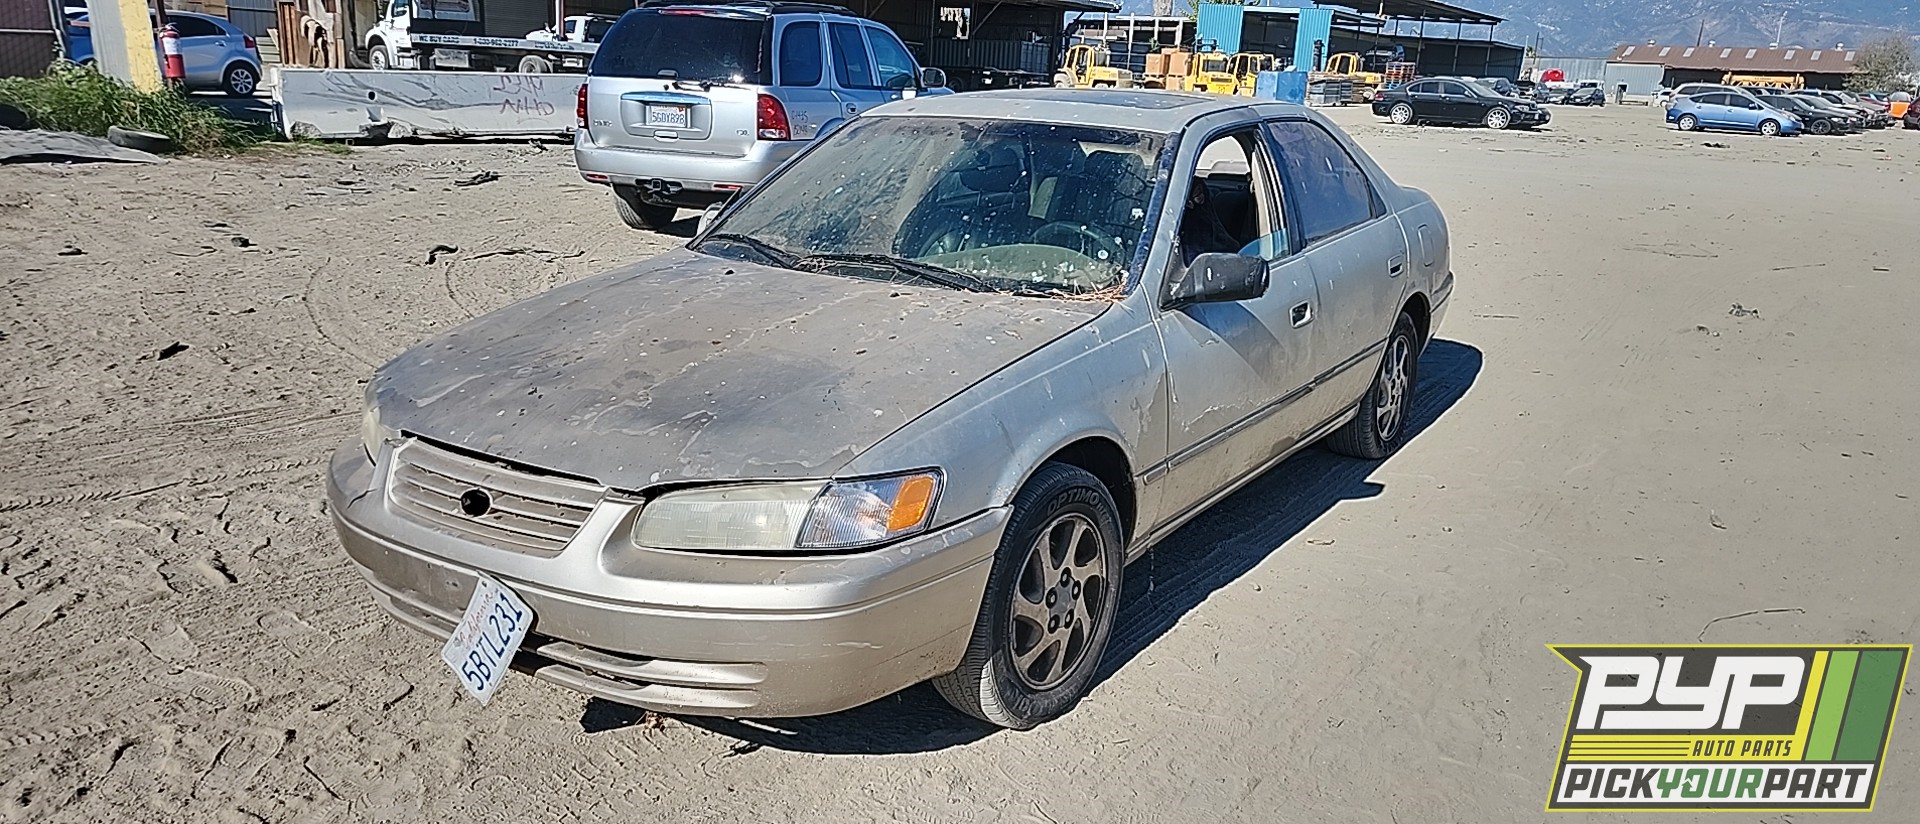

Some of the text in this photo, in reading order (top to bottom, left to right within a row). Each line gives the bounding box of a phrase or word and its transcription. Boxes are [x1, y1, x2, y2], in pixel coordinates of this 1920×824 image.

[418, 34, 428, 42] WE
[429, 35, 442, 43] BUY
[1046, 488, 1101, 517] OPTIMO
[460, 592, 523, 692] 5BTL231
